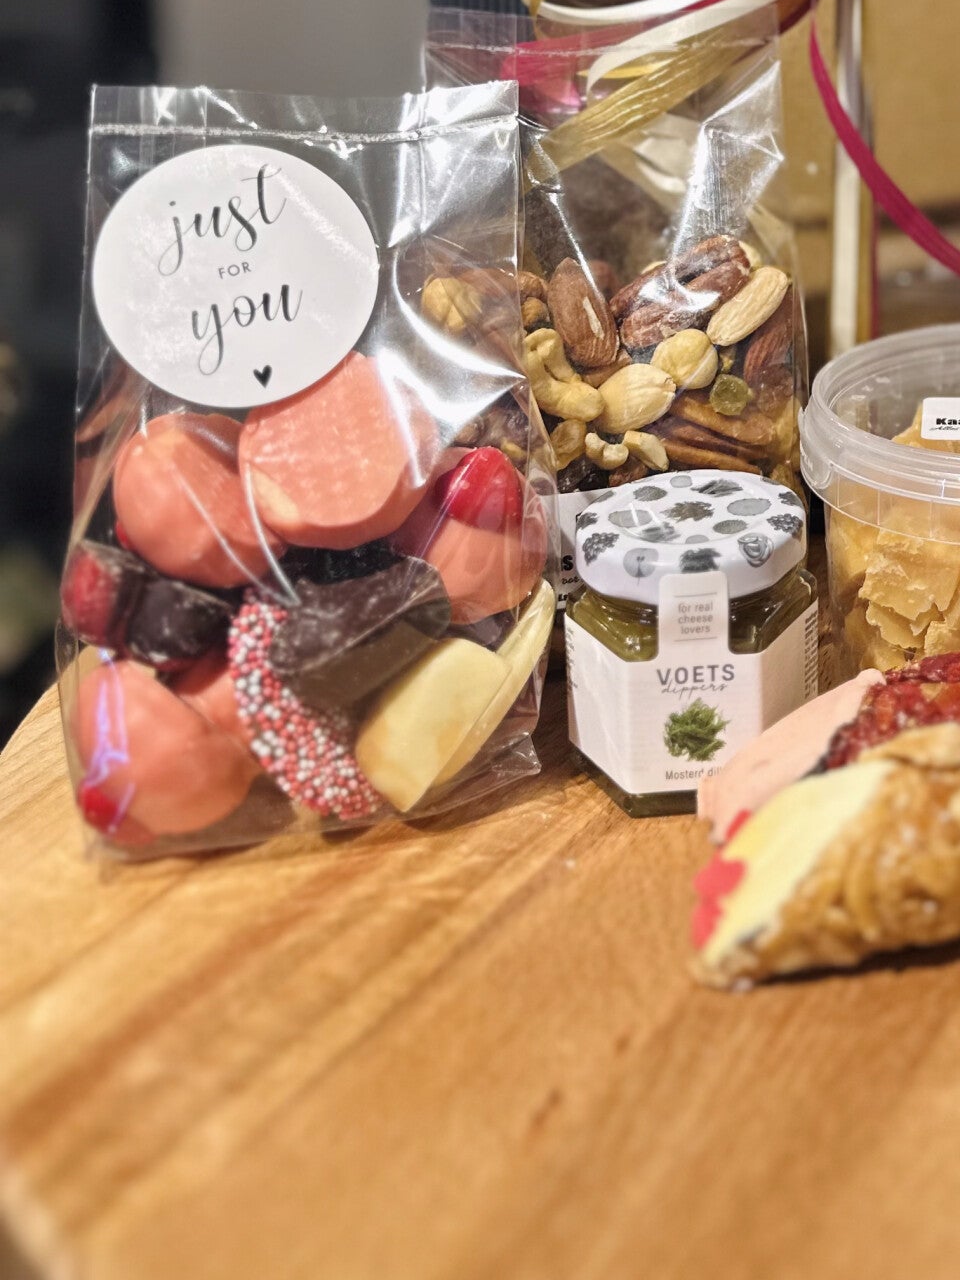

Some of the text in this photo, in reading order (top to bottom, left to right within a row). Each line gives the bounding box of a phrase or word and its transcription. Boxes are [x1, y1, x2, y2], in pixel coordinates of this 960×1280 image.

[157, 163, 288, 277] just
[218, 261, 252, 279] FOR
[191, 284, 304, 376] you
[678, 601, 714, 614] for real
[678, 613, 714, 625] cheese
[680, 624, 711, 635] lovers
[656, 663, 735, 686] VOETS
[661, 679, 729, 701] dippers
